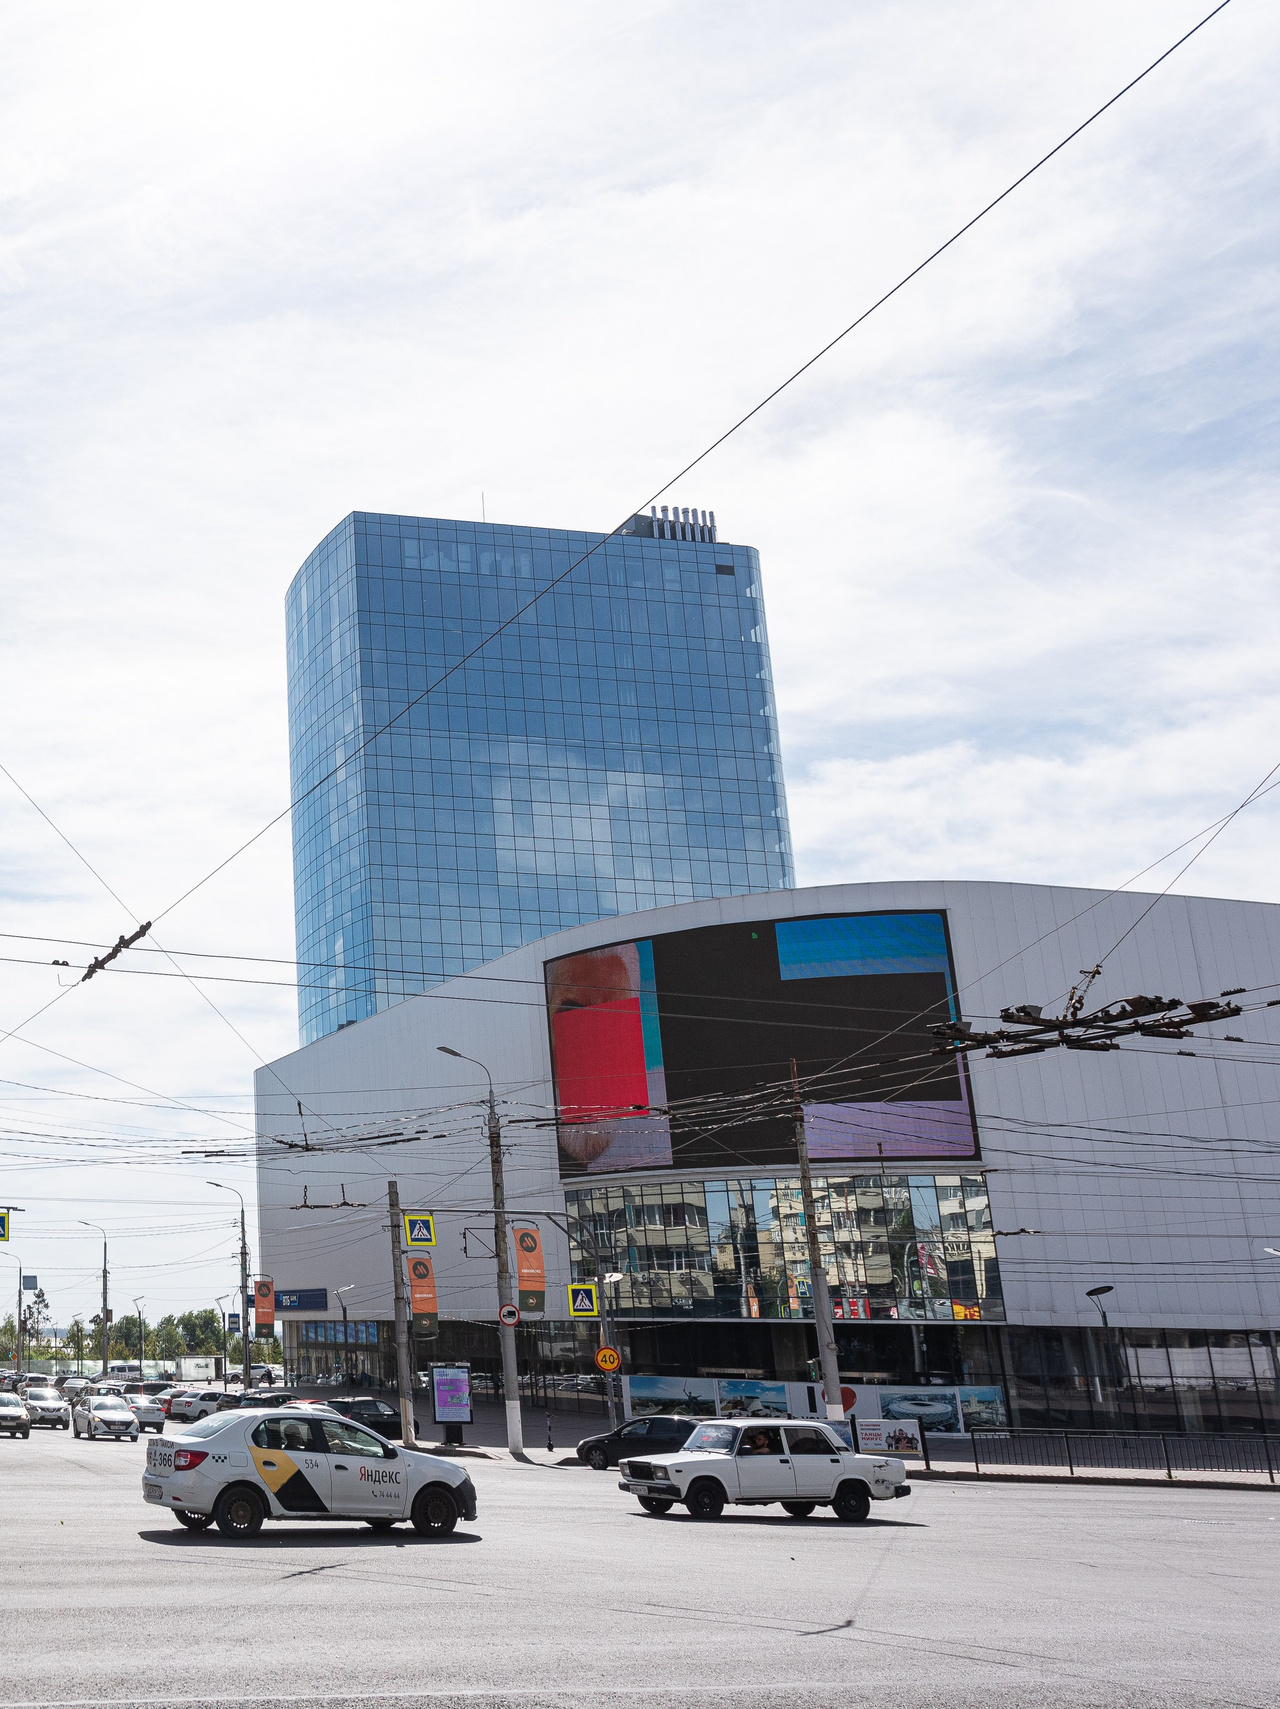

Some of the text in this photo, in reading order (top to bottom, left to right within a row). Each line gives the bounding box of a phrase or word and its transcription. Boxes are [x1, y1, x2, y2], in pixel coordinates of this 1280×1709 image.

[600, 1353, 615, 1365] 40
[158, 1452, 173, 1468] 366
[304, 1458, 319, 1470] 534
[359, 1465, 401, 1485] Яндекс
